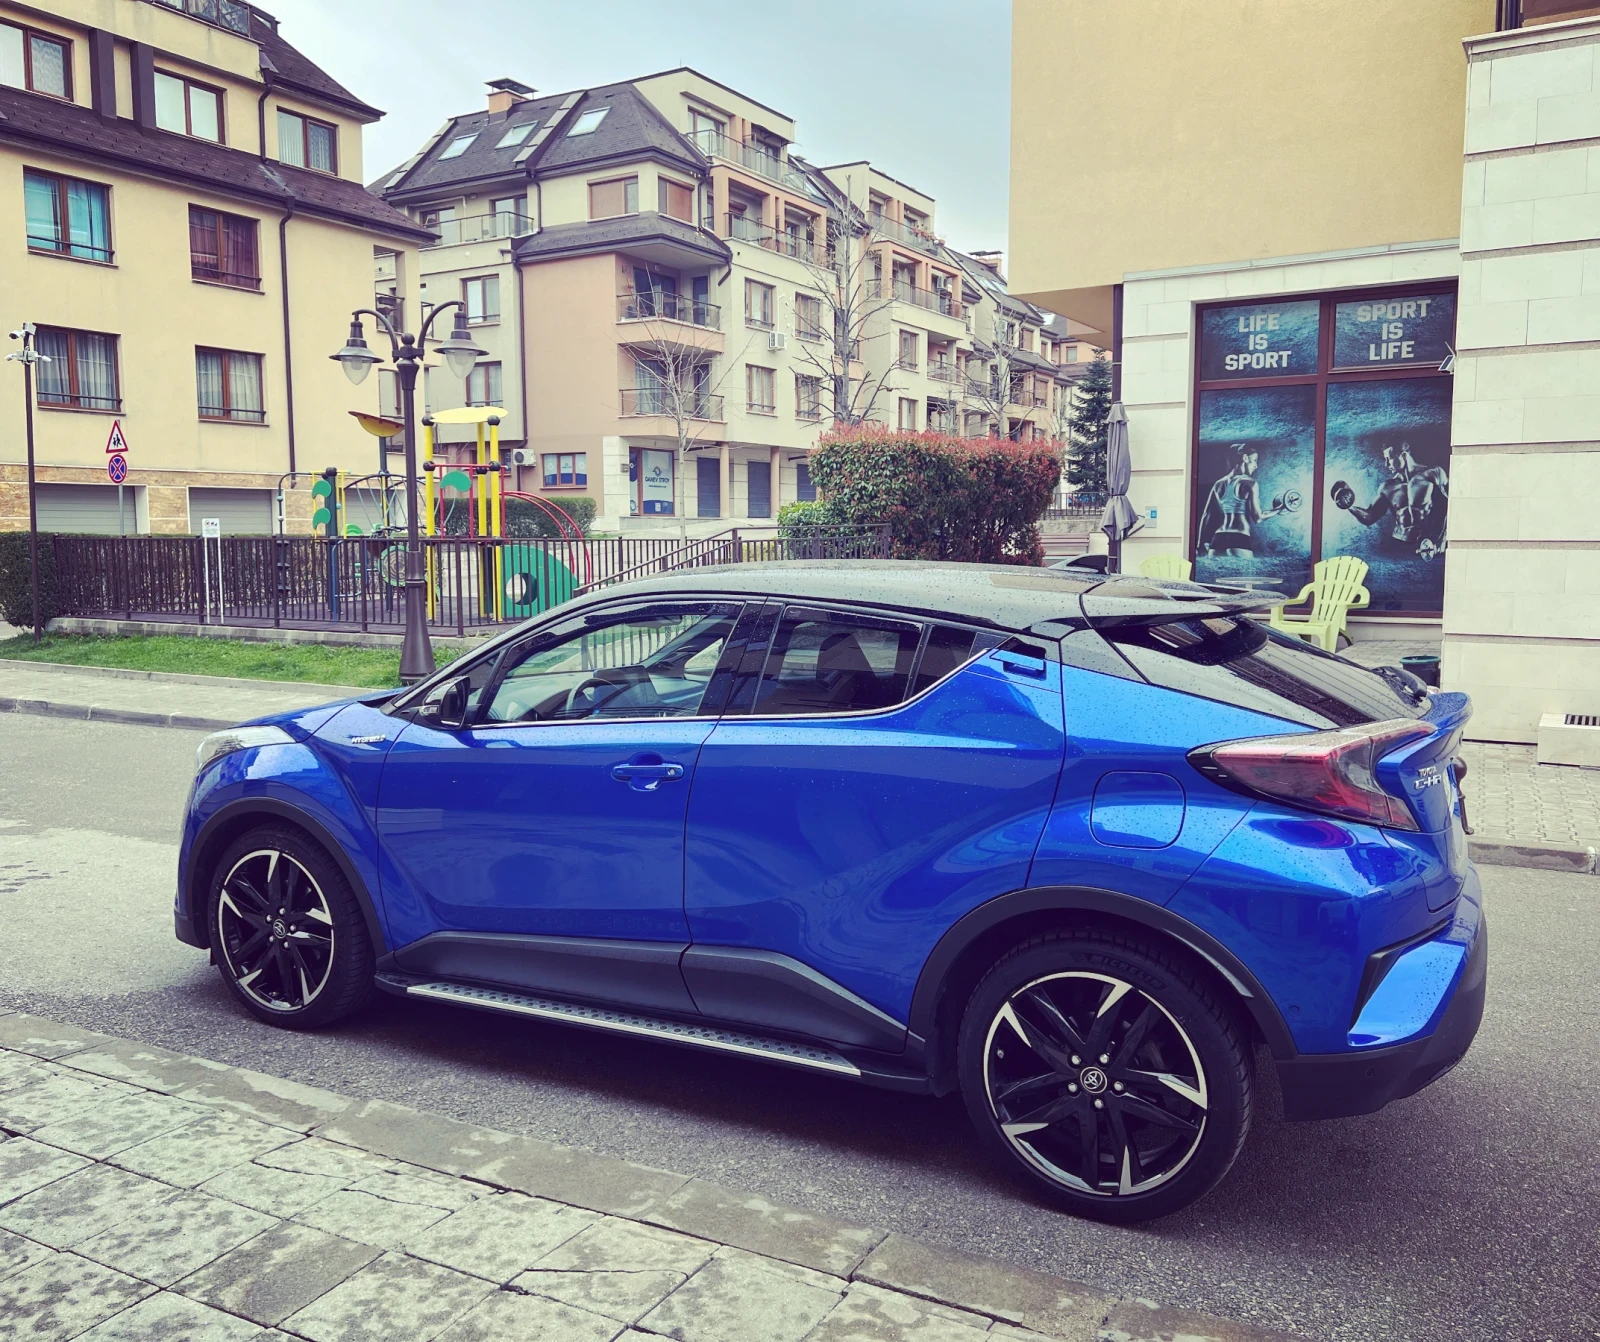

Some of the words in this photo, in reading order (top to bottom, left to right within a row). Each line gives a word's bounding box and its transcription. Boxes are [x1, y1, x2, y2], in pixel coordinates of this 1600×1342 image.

[1357, 300, 1431, 322] SPORT
[1239, 313, 1280, 332] LIFE
[1382, 322, 1403, 340] IS
[1249, 334, 1268, 350] IS
[1369, 341, 1415, 360] LIFE
[1225, 351, 1292, 370] SPORT
[1415, 774, 1441, 789] C-HR
[1417, 766, 1437, 778] TOYOTA
[1090, 954, 1163, 988] MICHELIN
